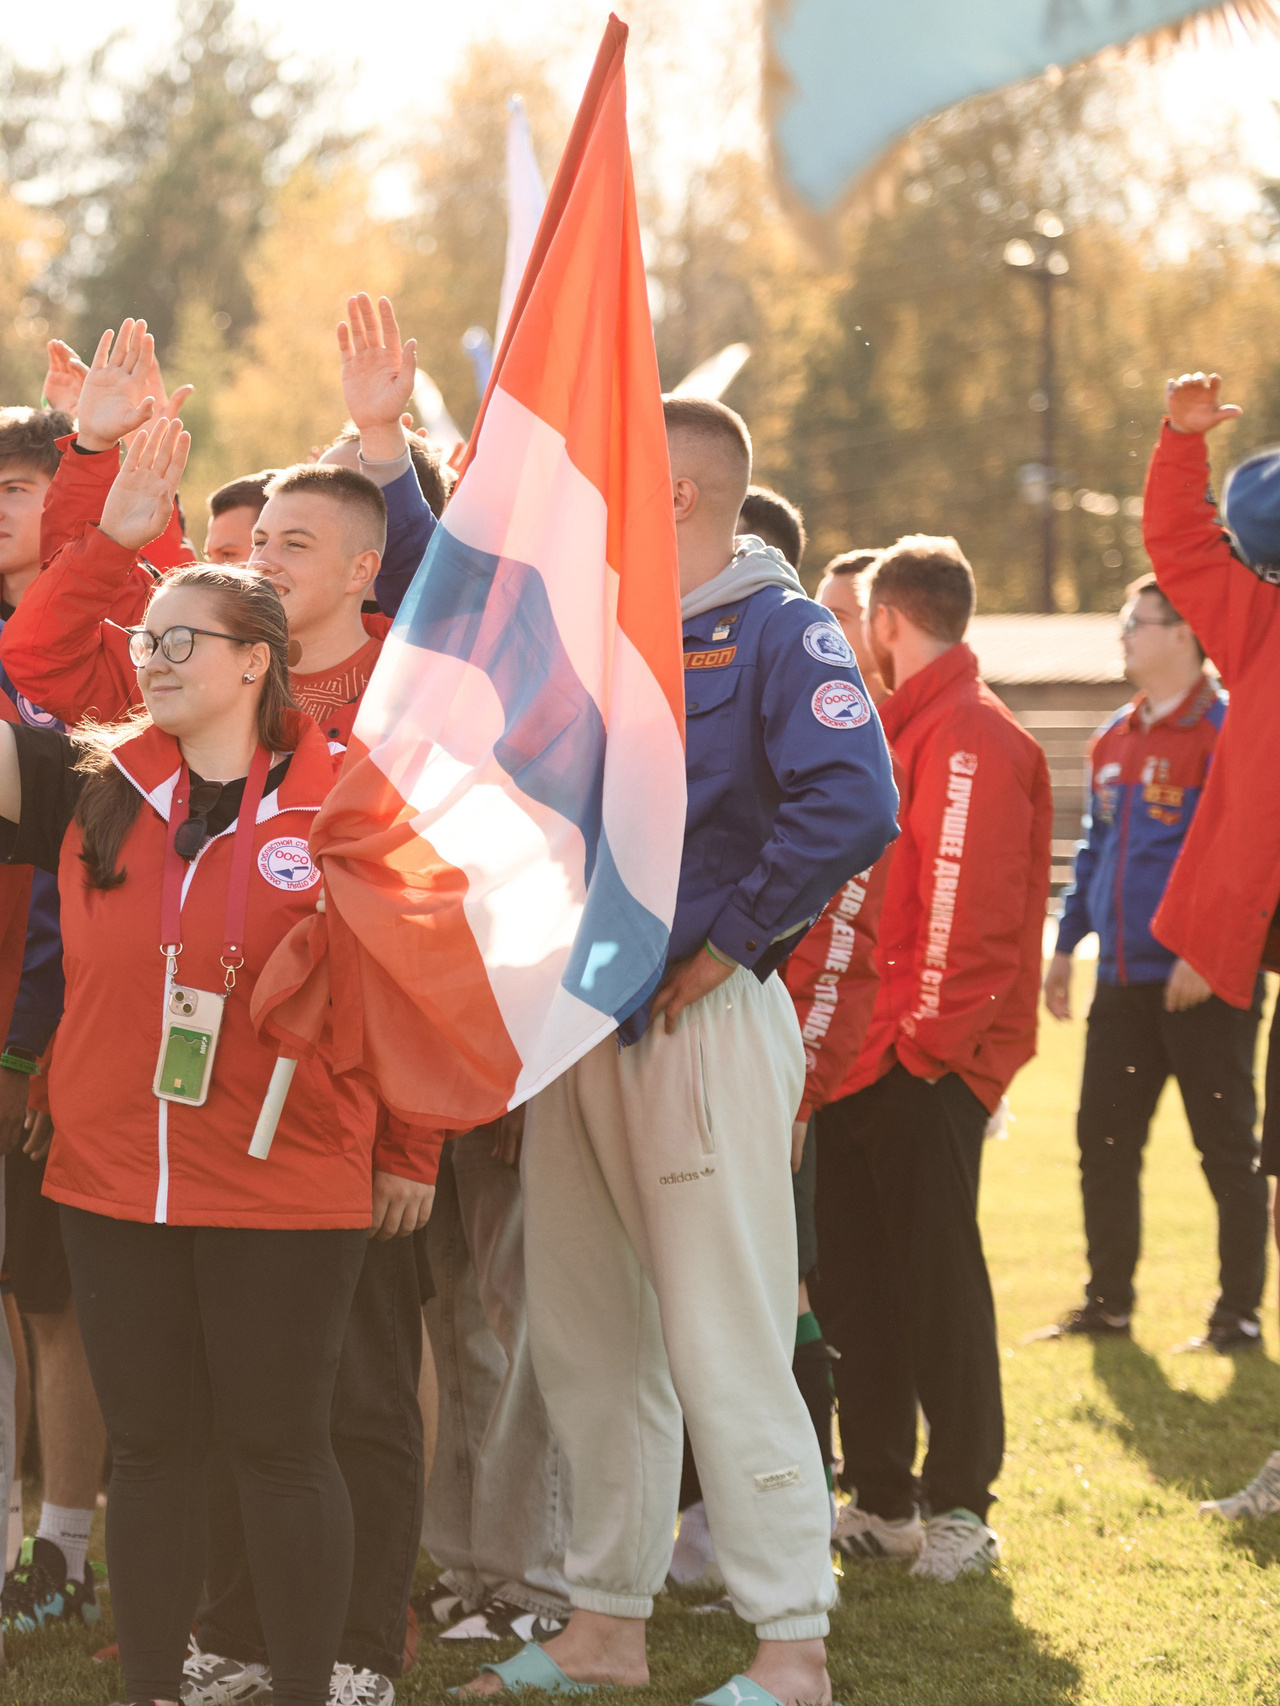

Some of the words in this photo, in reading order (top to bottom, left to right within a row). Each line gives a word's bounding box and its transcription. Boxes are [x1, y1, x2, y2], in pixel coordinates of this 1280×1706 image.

[825, 694, 856, 705] ООСО
[939, 774, 973, 858] ЛУЧШЕЕ
[275, 850, 309, 865] ООСО
[925, 858, 961, 970] ДВИЖЕНИЕ
[659, 1171, 699, 1185] adidas
